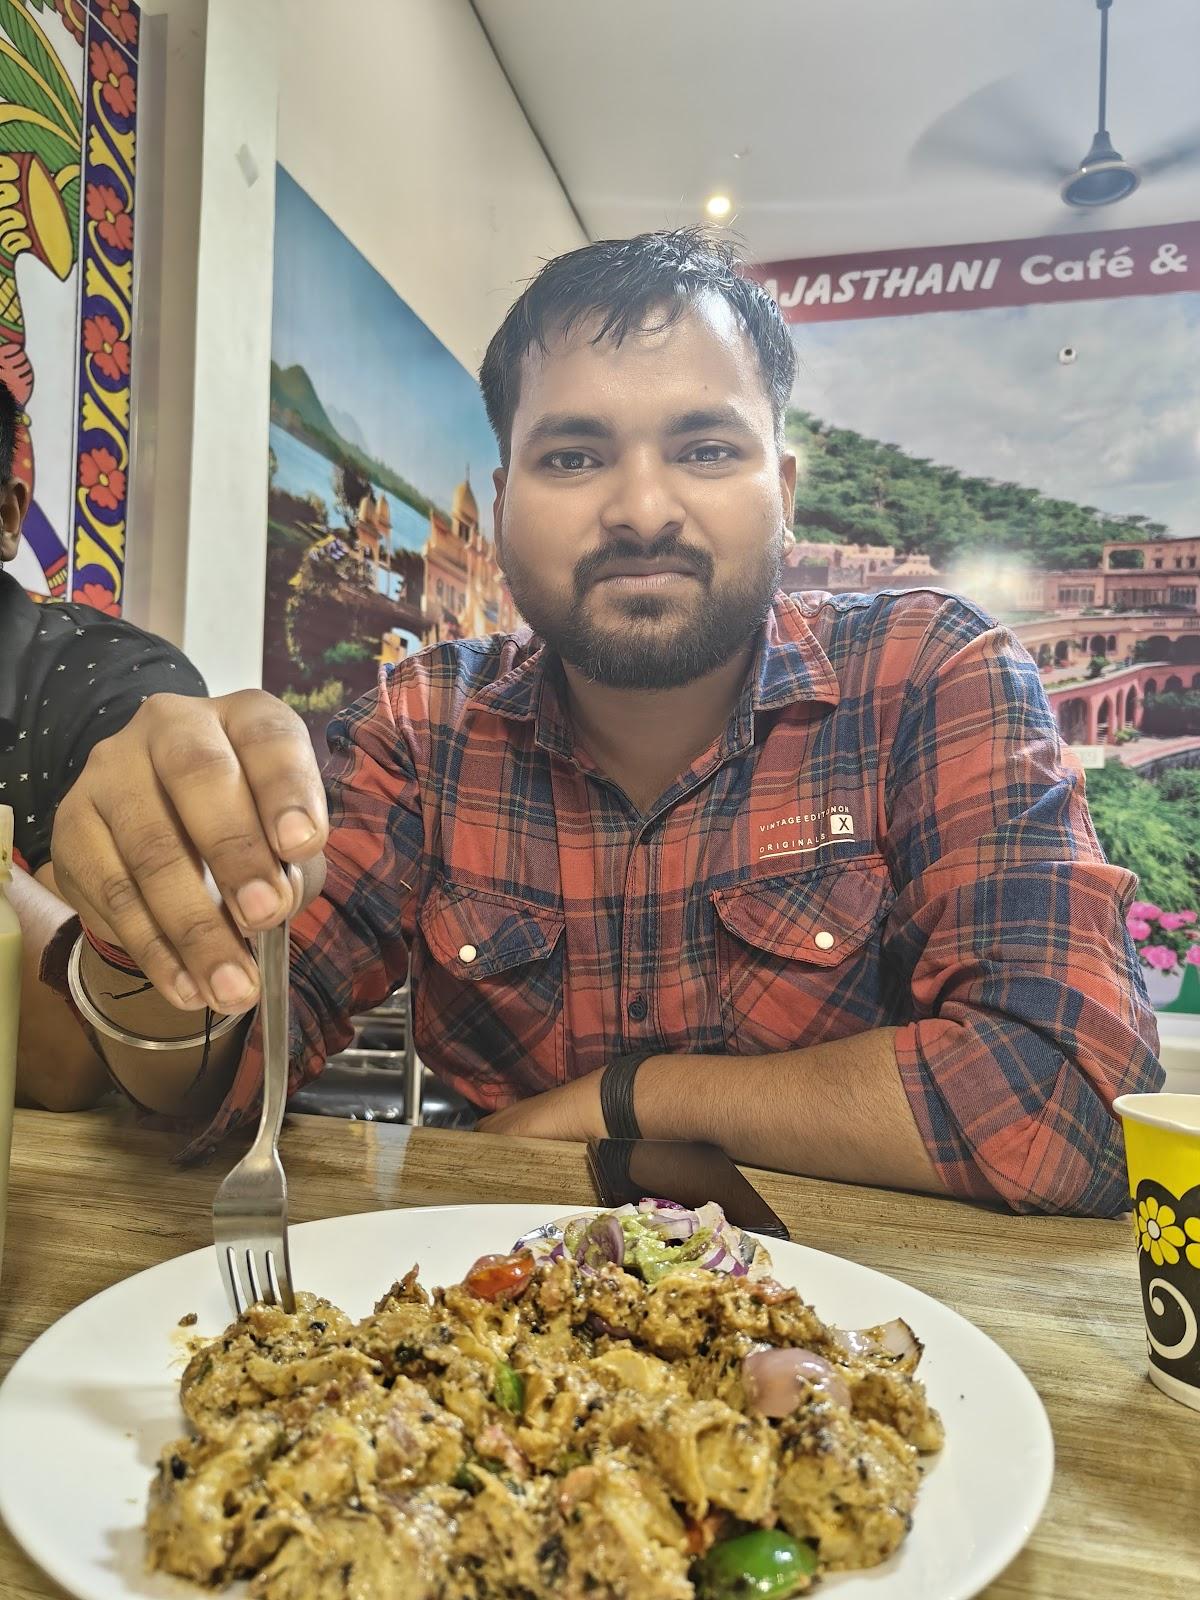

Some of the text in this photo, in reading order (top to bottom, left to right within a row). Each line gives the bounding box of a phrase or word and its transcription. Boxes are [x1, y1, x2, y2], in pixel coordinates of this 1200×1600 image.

[764, 242, 1189, 308] AJASTHANI Café &
[759, 815, 802, 832] VINTAGE
[838, 817, 850, 831] X
[759, 833, 826, 853] ORIGINALS
